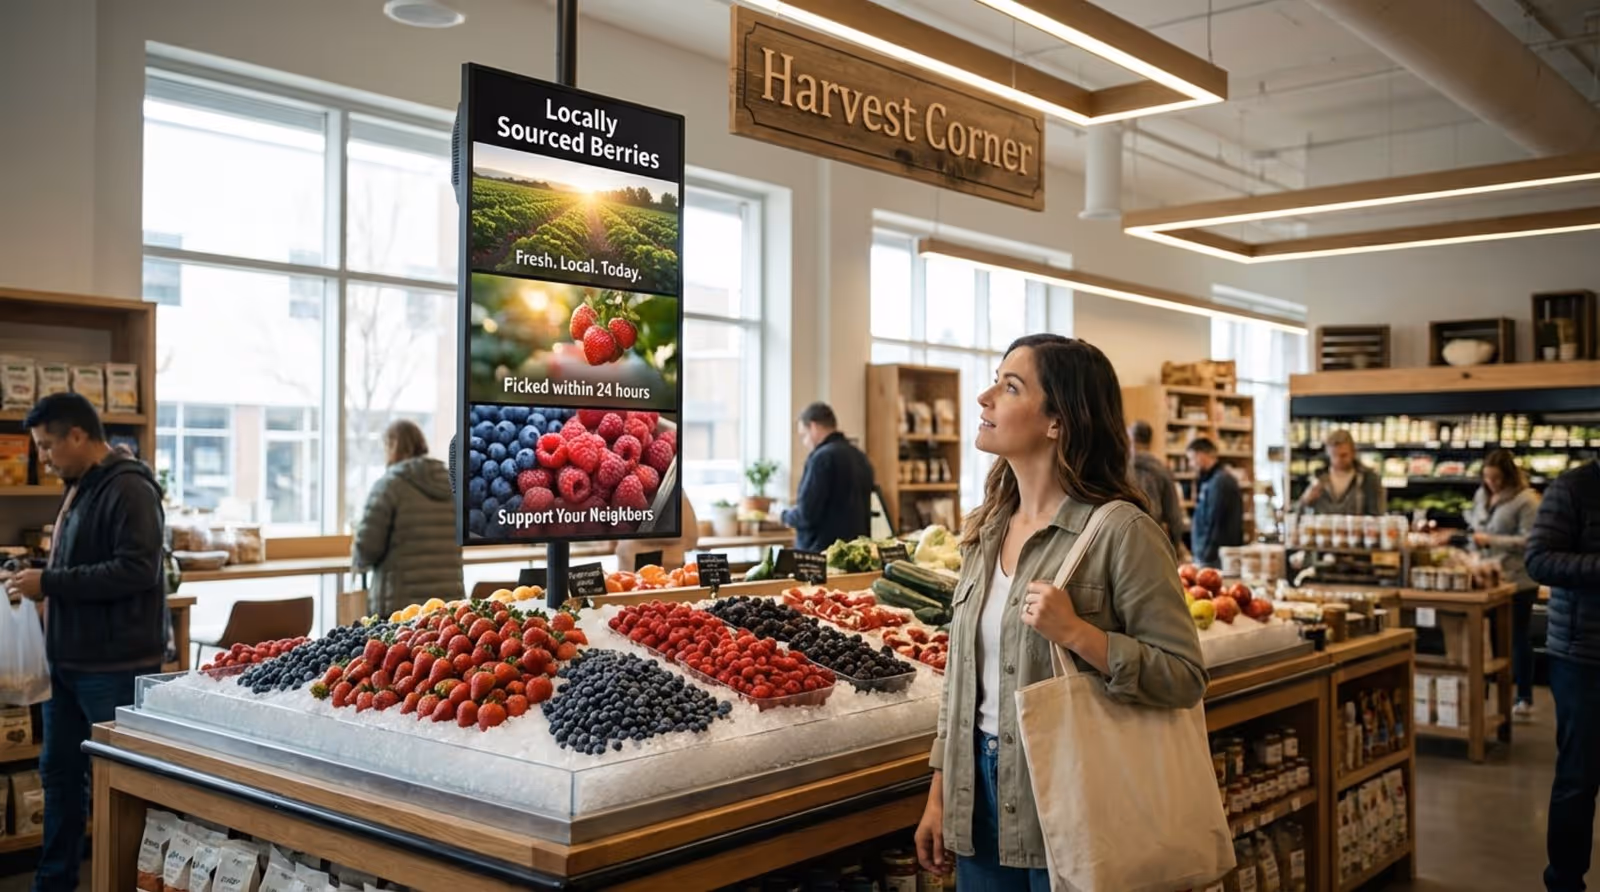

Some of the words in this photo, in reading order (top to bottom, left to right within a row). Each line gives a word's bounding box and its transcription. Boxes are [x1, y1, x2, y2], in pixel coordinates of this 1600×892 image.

[546, 98, 618, 138] Locally
[760, 47, 918, 143] Harvest
[924, 102, 1033, 176] Corner
[497, 115, 585, 154] Sourced
[590, 135, 660, 169] Berries
[515, 249, 557, 269] Fresh.
[560, 255, 599, 274] Local.
[601, 260, 642, 283] Today.
[503, 377, 549, 394] Picked
[552, 379, 594, 397] within
[596, 382, 612, 397] 24
[615, 382, 650, 399] hours
[497, 508, 554, 529] Support
[556, 507, 587, 524] Your
